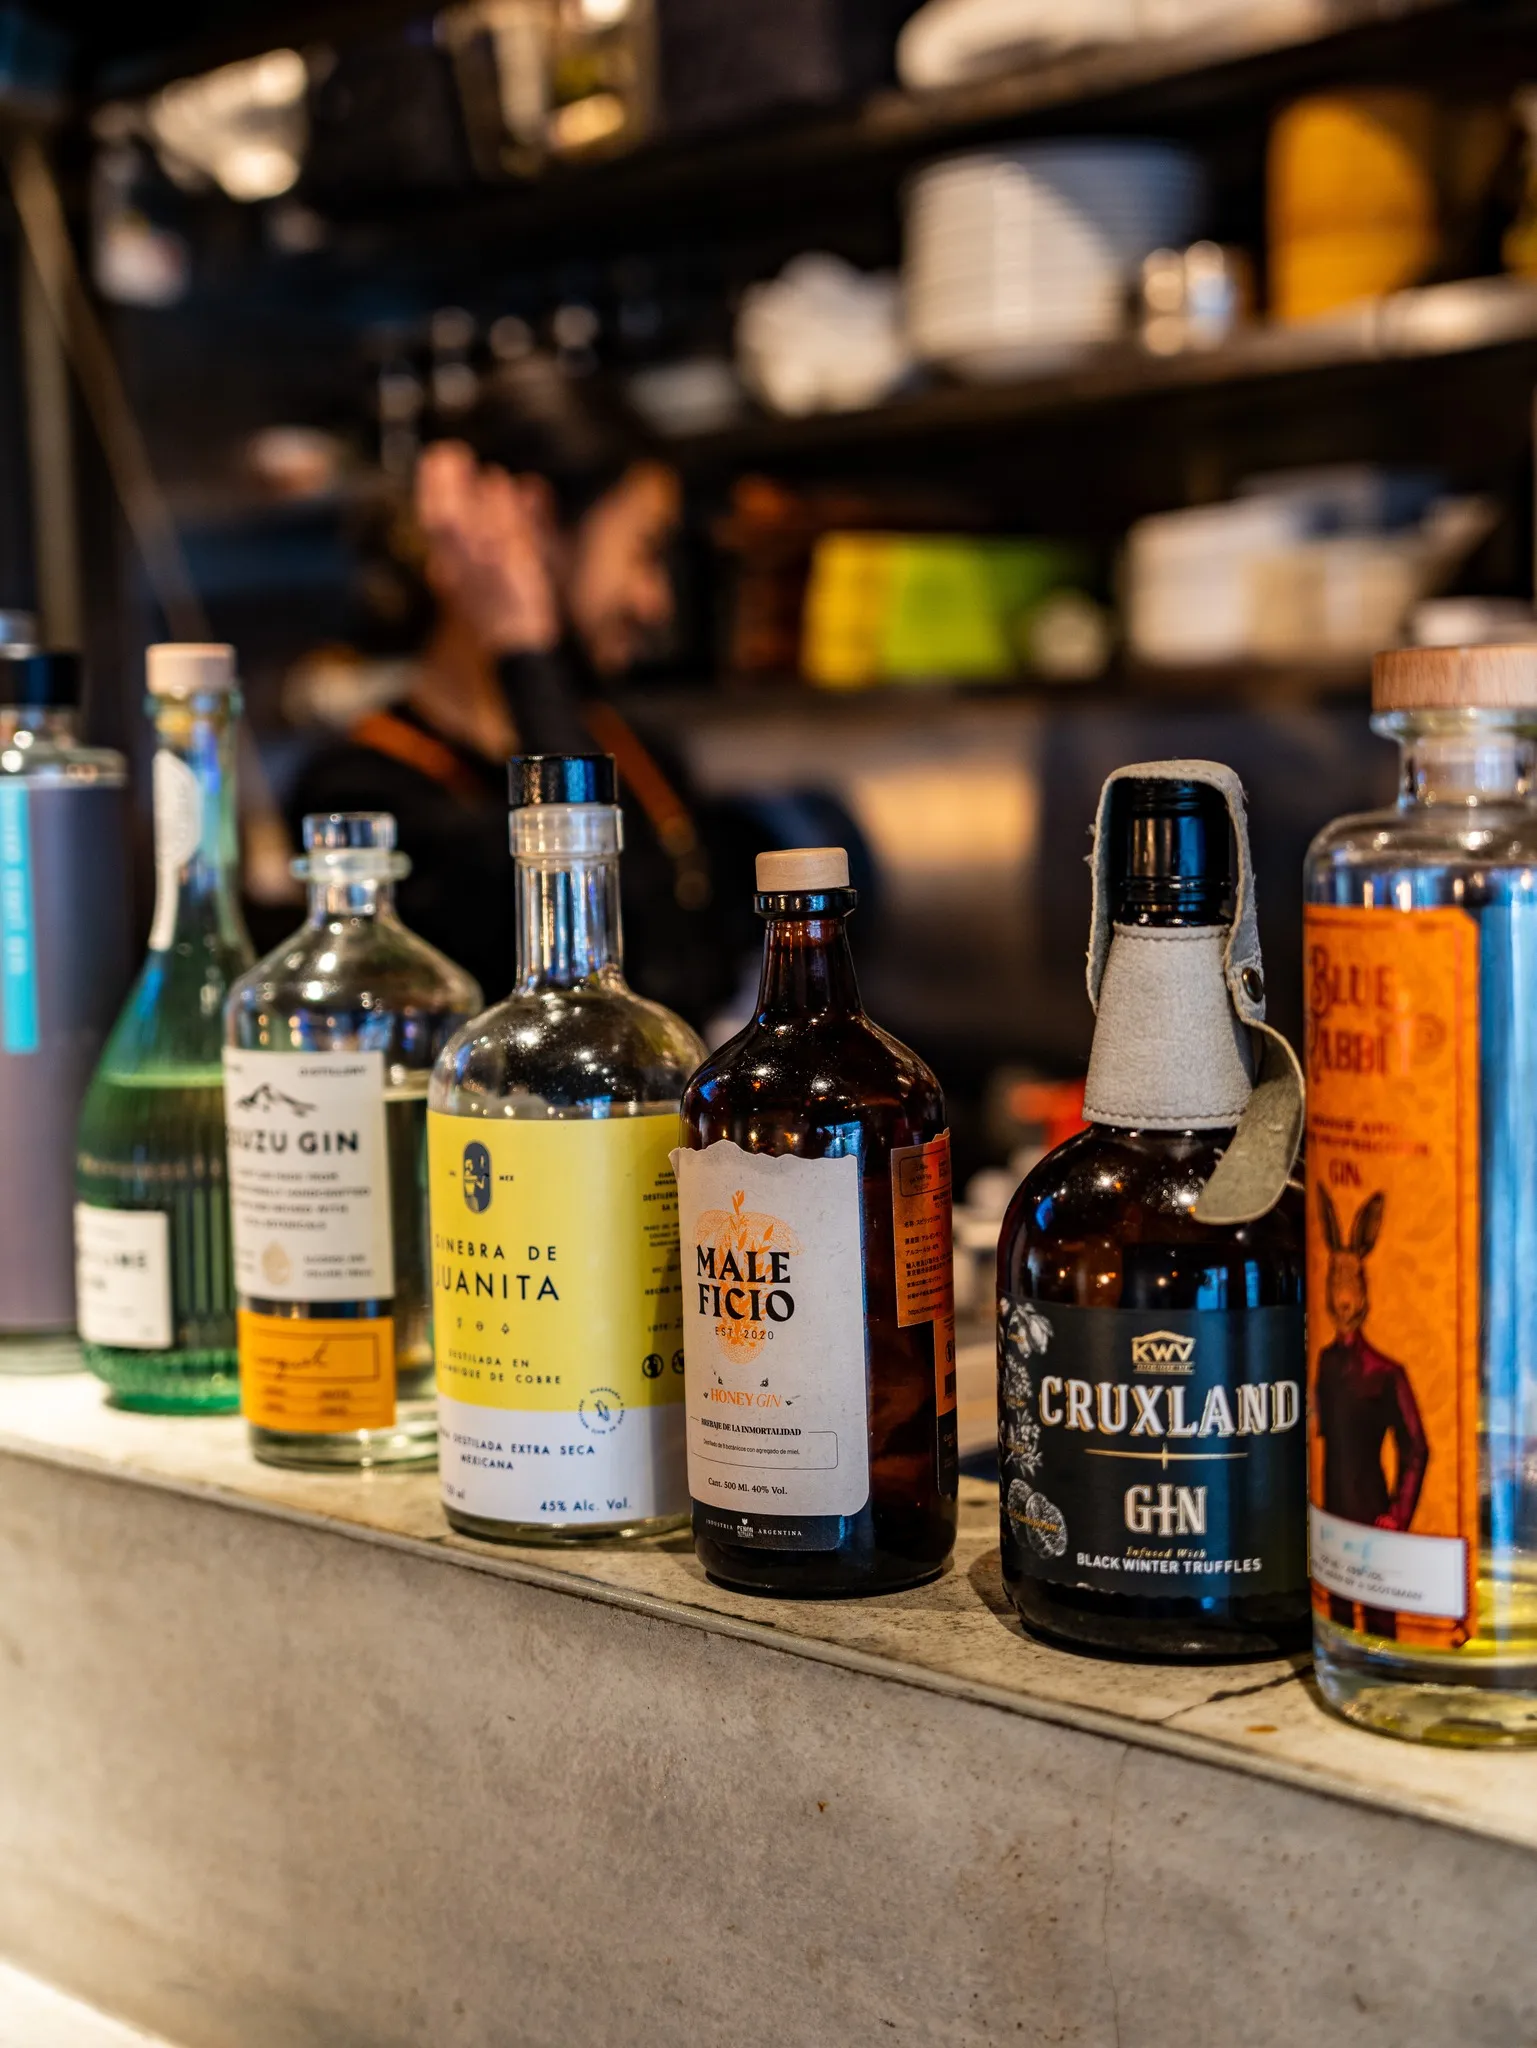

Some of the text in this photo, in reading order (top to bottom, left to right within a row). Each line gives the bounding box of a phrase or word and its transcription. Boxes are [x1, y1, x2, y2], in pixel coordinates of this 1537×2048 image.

[298, 1130, 359, 1154] GIN
[1329, 1159, 1362, 1188] GIN
[528, 1246, 556, 1261] DE
[697, 1244, 790, 1284] MALE
[435, 1262, 560, 1301] JUANITA
[698, 1283, 795, 1322] FICIO
[715, 1326, 774, 1340] EST 2020
[1132, 1337, 1195, 1363] KWV
[512, 1358, 529, 1368] EN
[489, 1371, 504, 1382] DE
[515, 1373, 561, 1385] COBRE
[711, 1388, 782, 1408] HONEY GIN
[1039, 1375, 1300, 1438] CRUXLAND
[722, 1422, 732, 1432] DE
[731, 1425, 741, 1433] LA
[741, 1426, 802, 1436] INMORTALIDAD
[453, 1432, 503, 1452] DESTILADA
[511, 1443, 550, 1455] EXTRA
[560, 1444, 596, 1456] SECA
[726, 1443, 747, 1453] botánicos
[756, 1447, 780, 1455] agregado
[780, 1447, 787, 1455] de
[787, 1447, 800, 1455] miel.
[460, 1452, 514, 1471] MEXICANA
[708, 1477, 788, 1495] Cant. 500 Ml. 40% Vol.
[540, 1497, 632, 1513] 45% Alc. Vol.
[1124, 1484, 1208, 1537] GIN
[705, 1518, 734, 1530] INDUSTRIA
[757, 1528, 802, 1536] ARGENTINA
[1126, 1545, 1207, 1558] Infused With
[1076, 1552, 1263, 1574] BLACK WINTER TRUFFLES
